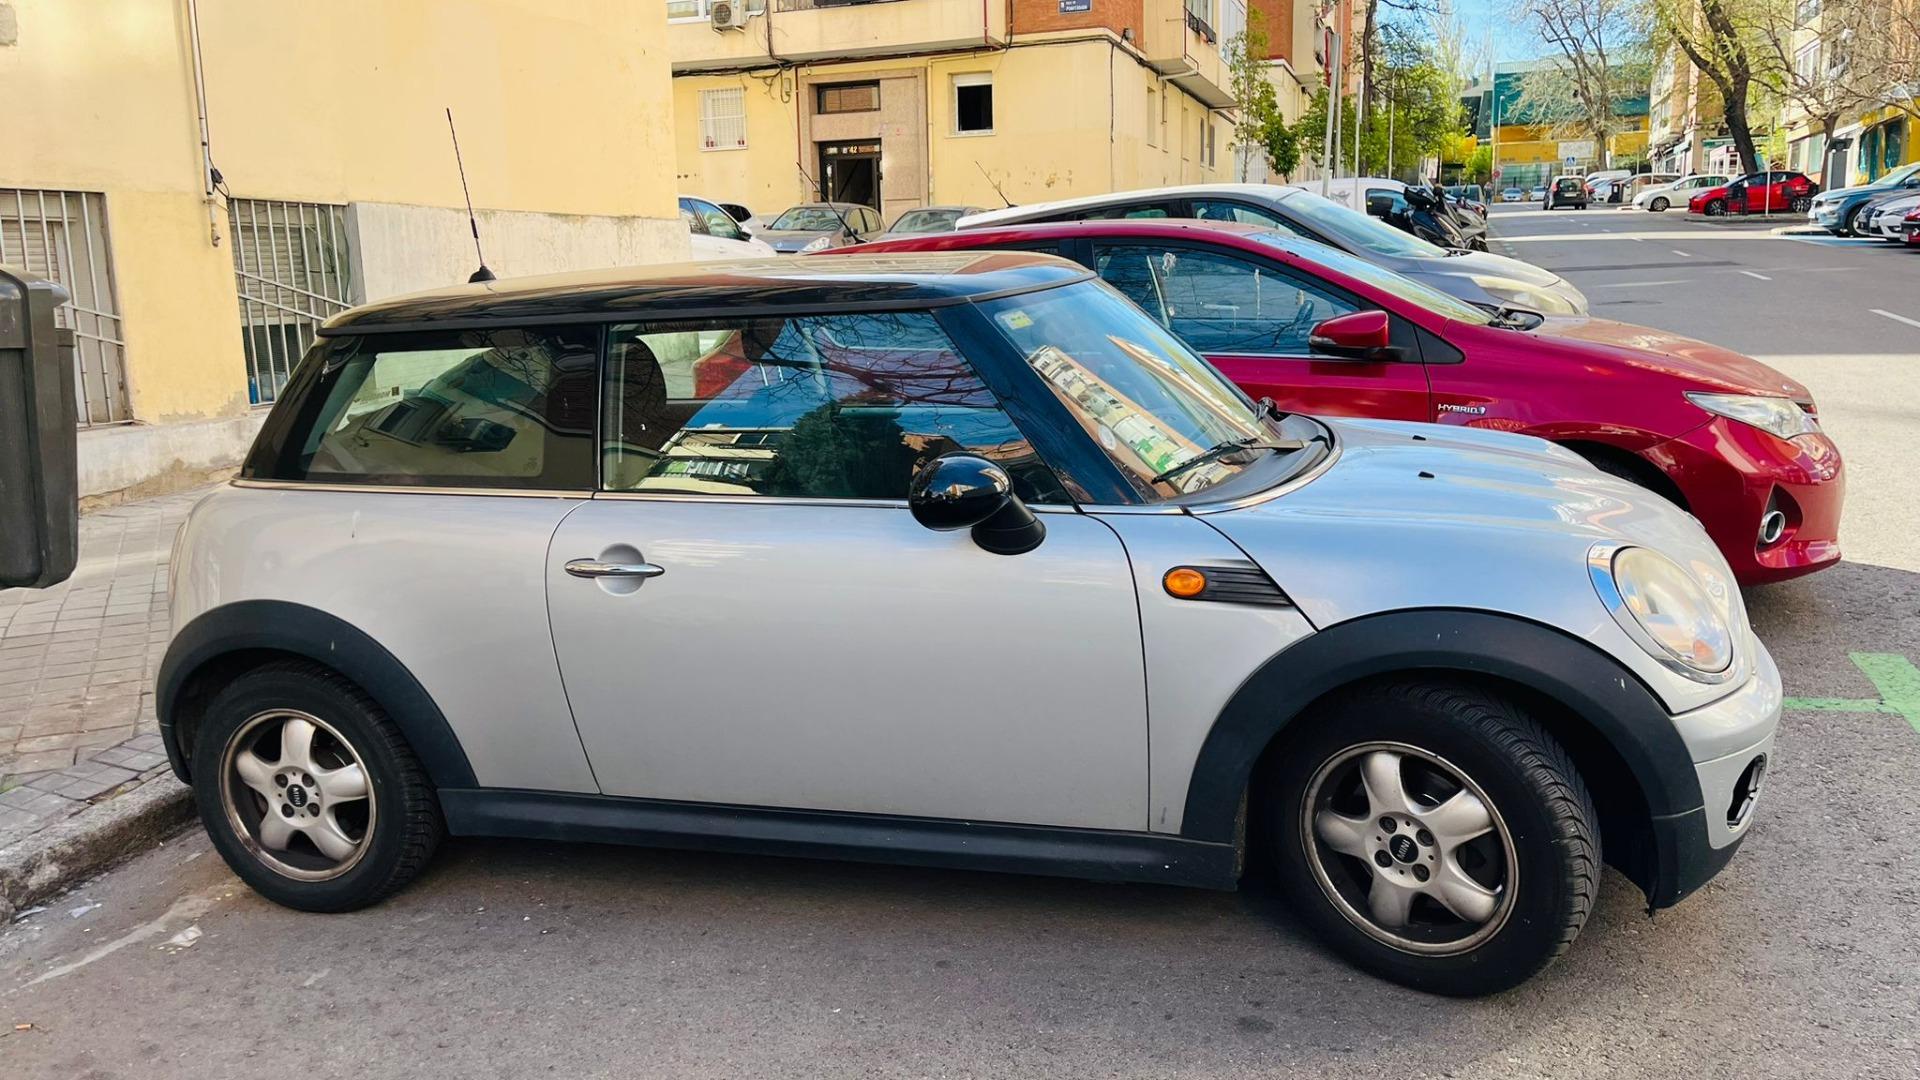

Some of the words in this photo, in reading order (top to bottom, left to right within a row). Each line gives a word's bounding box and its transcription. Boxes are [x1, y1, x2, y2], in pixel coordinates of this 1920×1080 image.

[1437, 403, 1478, 414] HYBRID
[292, 787, 301, 805] MINI
[1396, 838, 1411, 860] MINI
